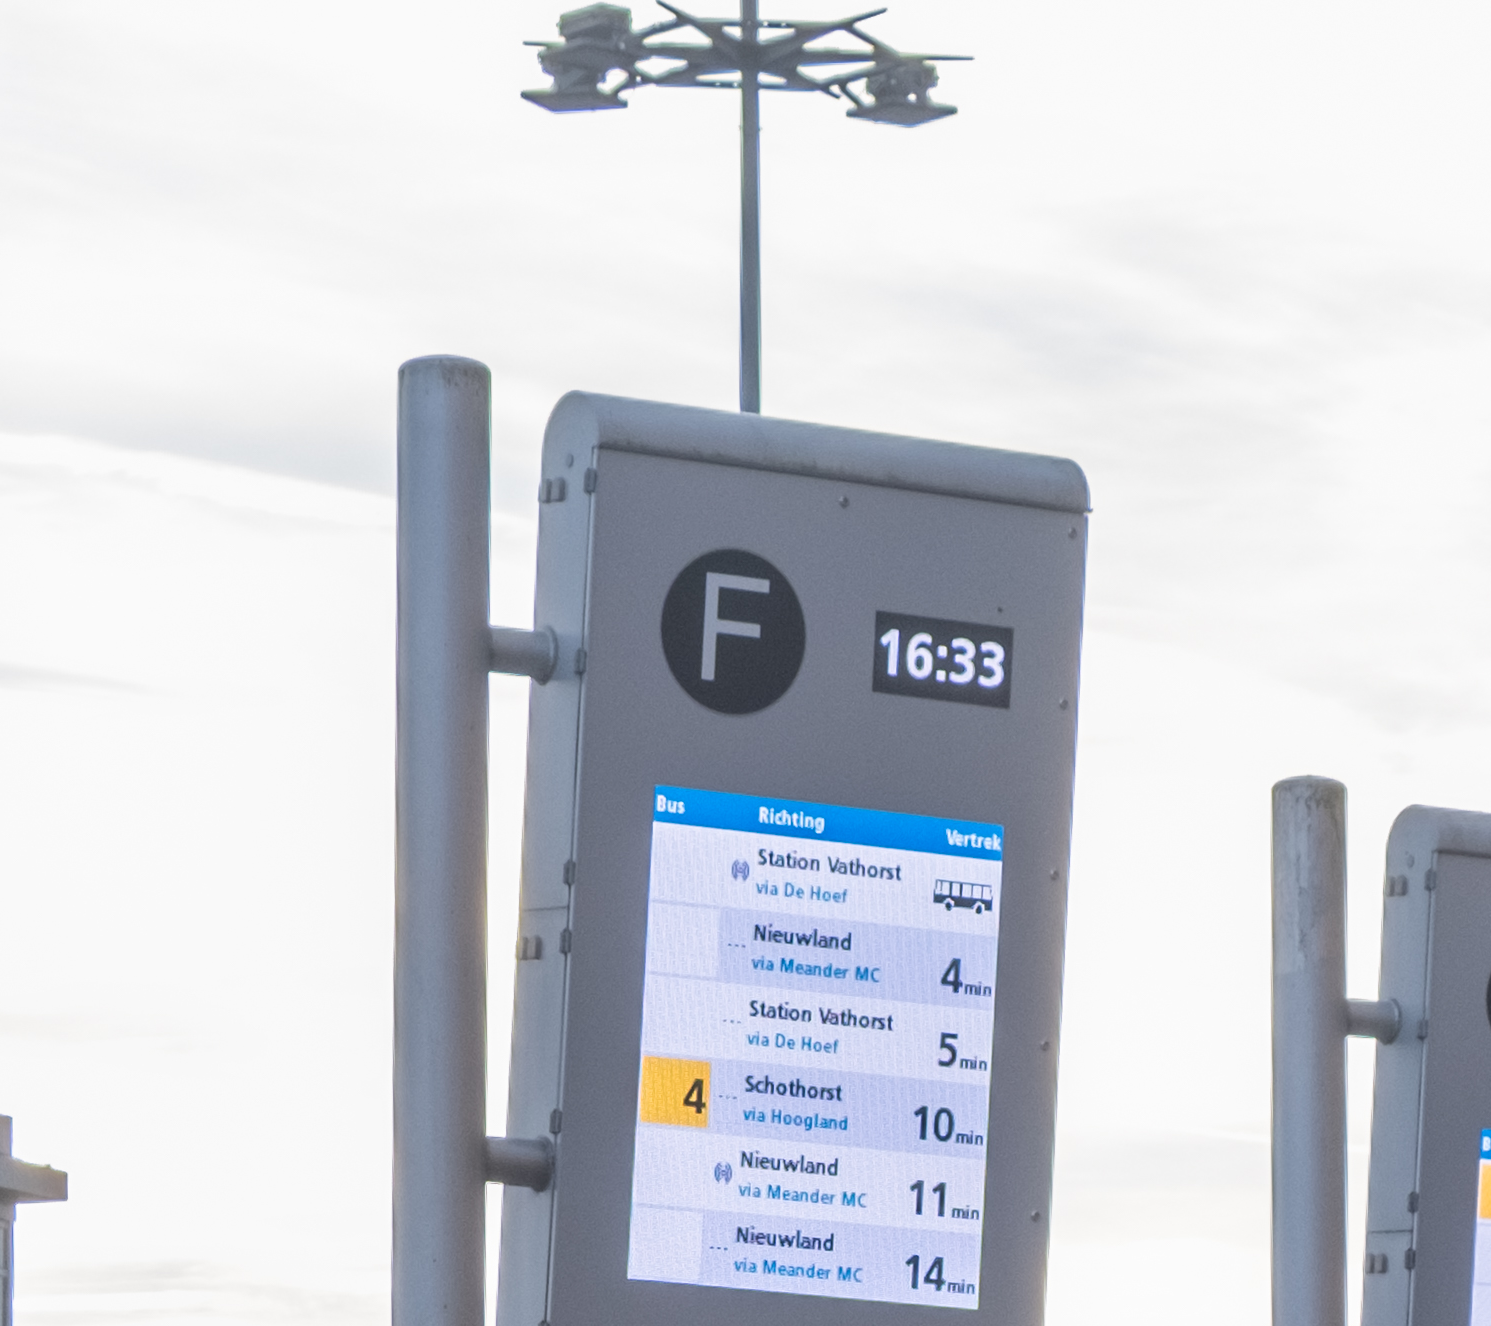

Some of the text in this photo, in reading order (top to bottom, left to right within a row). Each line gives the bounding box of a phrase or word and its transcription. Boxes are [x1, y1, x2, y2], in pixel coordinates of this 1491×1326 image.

[700, 572, 770, 681] F
[880, 627, 1006, 689] 16:33
[656, 796, 1001, 851] Bus Richting Vertrek
[758, 850, 901, 880] Station Vathorst
[756, 881, 848, 903] via De Hoef
[754, 924, 852, 951] Nieuwland
[941, 958, 962, 993] 4
[750, 1000, 893, 1031] Station Vathorst
[938, 1032, 958, 1067] 5
[683, 1076, 842, 1114] 4 Schothorst
[913, 1105, 954, 1142] 10
[740, 1151, 838, 1176] Nieuwland
[910, 1180, 947, 1217] 11
[736, 1226, 834, 1251] Nieuwland
[905, 1254, 945, 1291] 14
